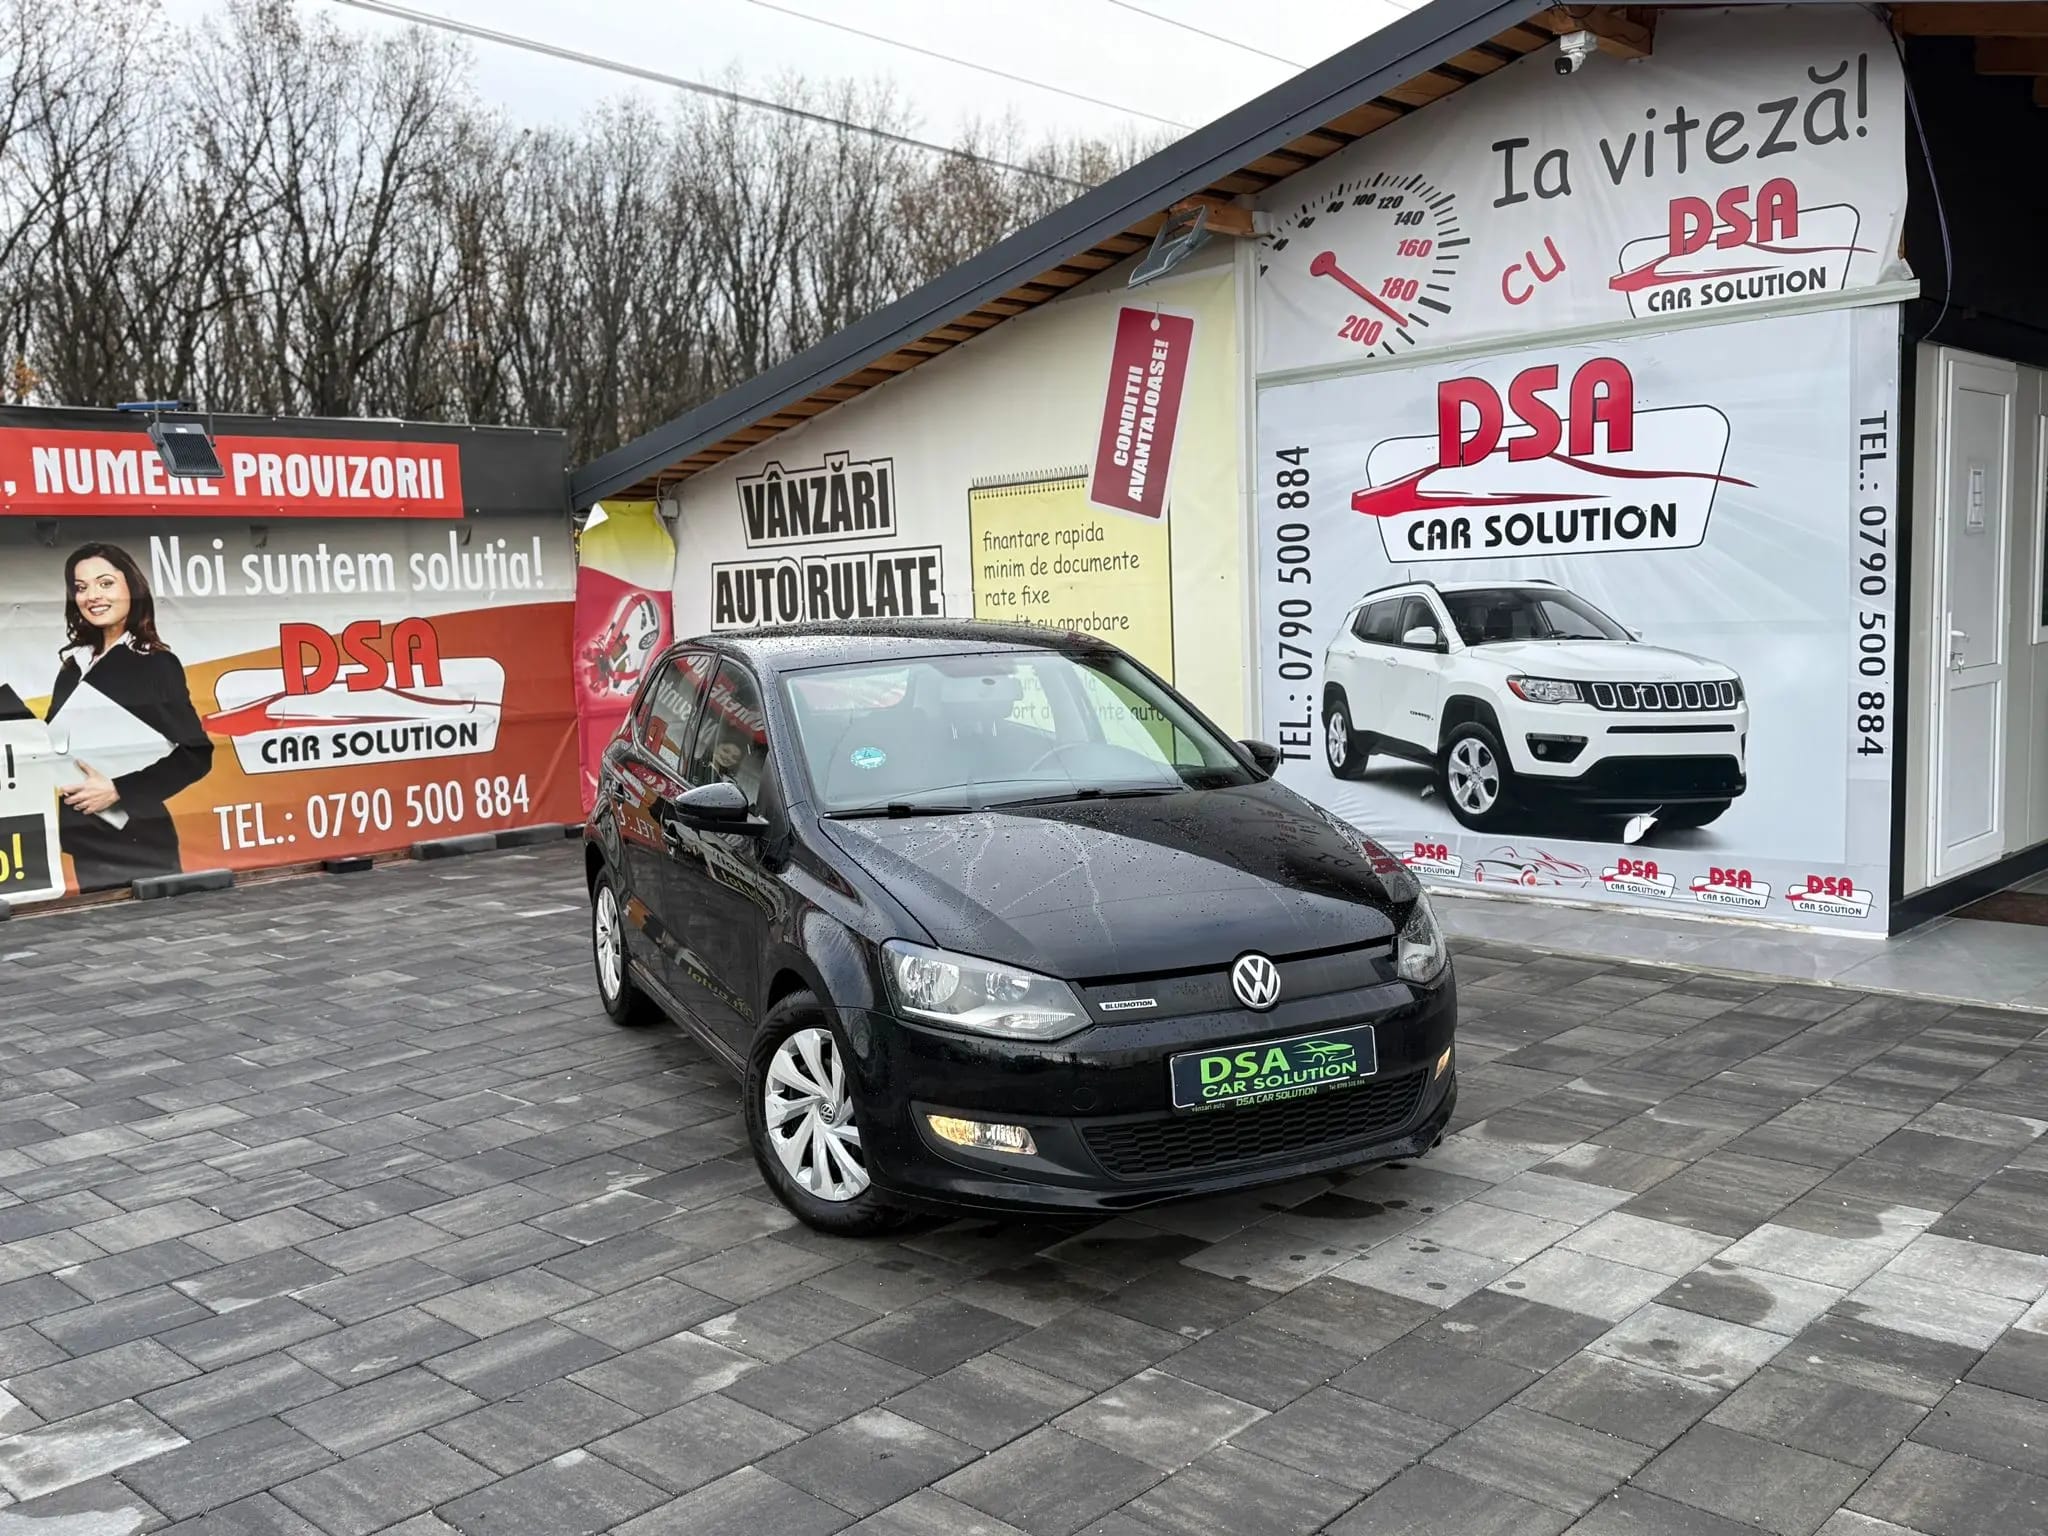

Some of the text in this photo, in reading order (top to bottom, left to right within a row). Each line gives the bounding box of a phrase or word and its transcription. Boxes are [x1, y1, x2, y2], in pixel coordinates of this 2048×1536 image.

[1491, 53, 1868, 209] Ia viteză!
[1352, 193, 1377, 206] 100
[1377, 196, 1404, 209] 120
[1669, 177, 1798, 256] DSA
[1393, 210, 1425, 226] 140
[1396, 238, 1433, 258] 160
[1501, 236, 1567, 306] cu
[1379, 276, 1419, 301] 180
[1647, 267, 1826, 313] CAR SOLUTION
[1337, 314, 1383, 346] 200
[1113, 365, 1144, 468] CONDITII
[1127, 338, 1169, 502] AVANTAJOASE!
[1437, 356, 1634, 469] DSA
[231, 452, 445, 499] PROVIZORII
[742, 460, 891, 540] VÂNZĂRI
[983, 521, 1104, 552] finantare rapida
[1407, 502, 1677, 551] CAR SOLUTION
[149, 536, 227, 597] Noi
[241, 543, 396, 595] suntem
[984, 551, 1140, 579] minim de documente
[715, 555, 939, 624] AUTO RULATE
[985, 585, 1051, 607] rate fixe
[1856, 409, 1888, 757] TEL.: 0790 500 884
[1276, 445, 1313, 765] TEL.: 0790 500 884
[279, 617, 443, 696] DSA
[261, 722, 478, 764] CAR SOLUTION
[213, 774, 530, 850] TEL.: 0790 500 884
[1414, 842, 1448, 861] DSA
[1617, 857, 1658, 880] DSA
[1423, 867, 1456, 876] SOLUTION
[1709, 867, 1752, 889] DSA
[1806, 874, 1853, 897] DSA
[1610, 883, 1666, 897] CAR SOLUTION
[1702, 893, 1761, 907] CAR SOLUTION
[1799, 902, 1862, 915] CAR SOLUTION
[1105, 1000, 1153, 1009] BLUEMOTION
[1200, 1047, 1291, 1085] DSA
[1202, 1080, 1247, 1097] CAR
[1253, 1060, 1357, 1090] SOLUTION
[1236, 1086, 1318, 1107] DSA CAR SOLUTION
